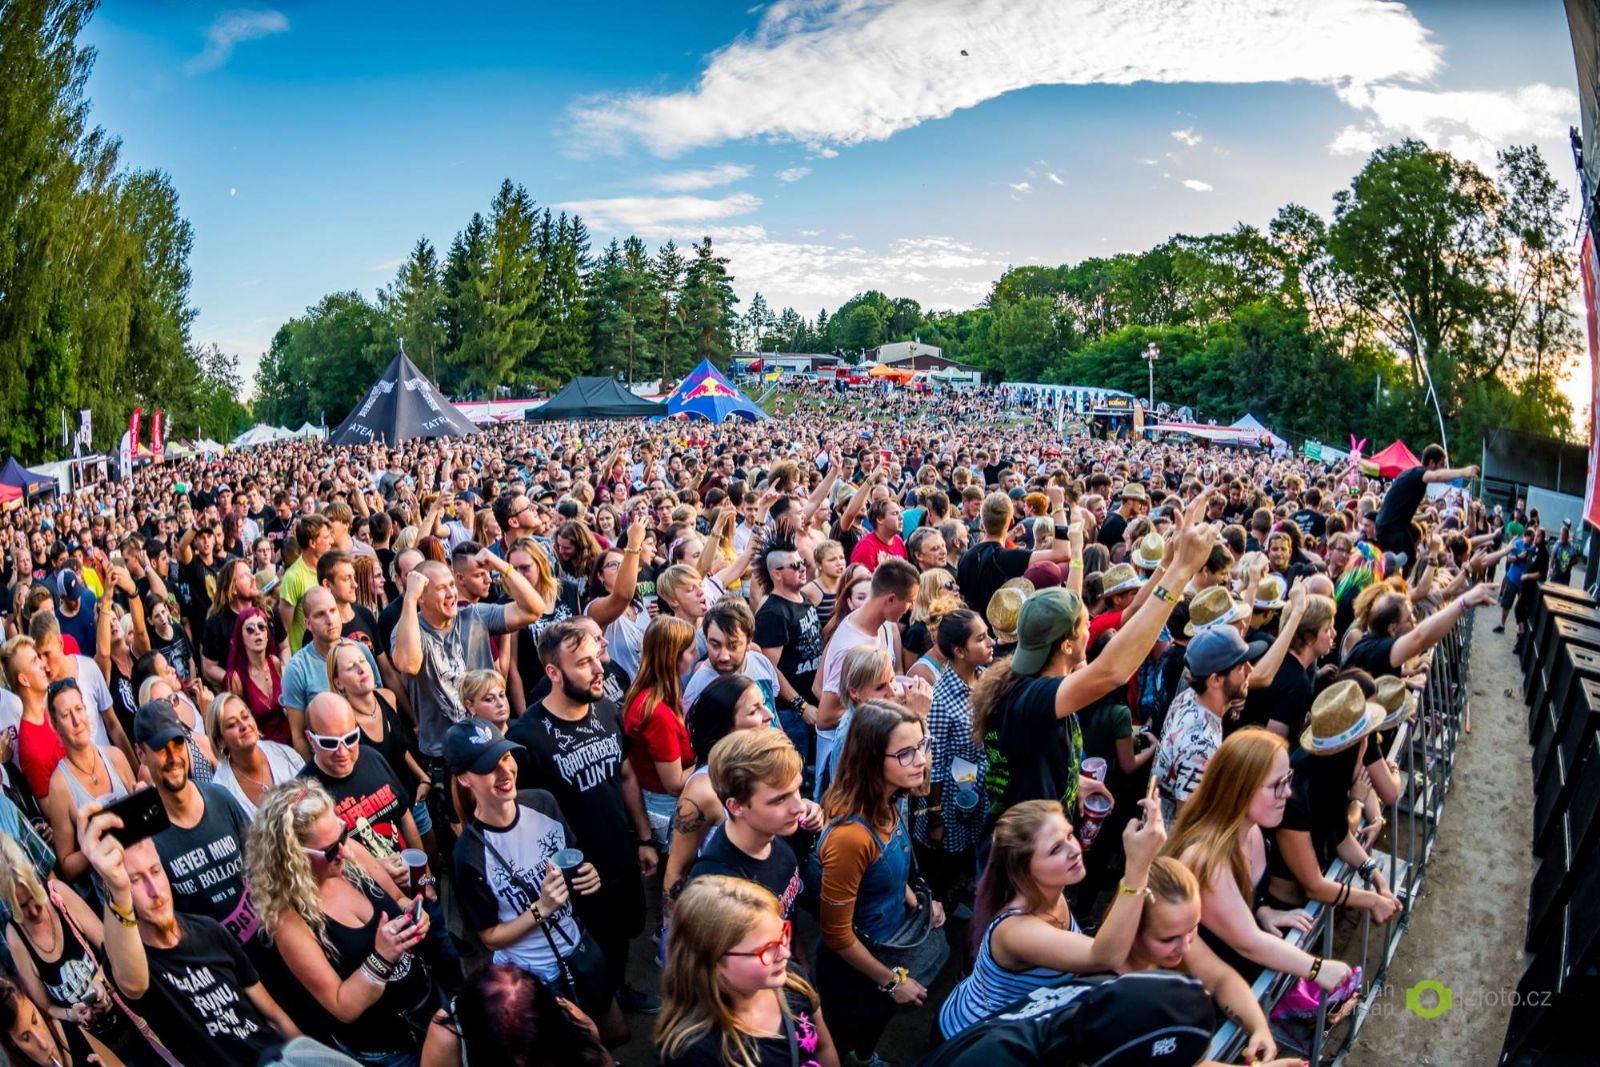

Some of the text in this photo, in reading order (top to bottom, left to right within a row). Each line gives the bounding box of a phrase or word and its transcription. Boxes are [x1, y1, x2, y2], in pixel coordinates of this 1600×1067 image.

[576, 756, 617, 792] LUNT
[169, 834, 237, 879] NEVER MIND
[171, 855, 244, 895] THE BOLLOC
